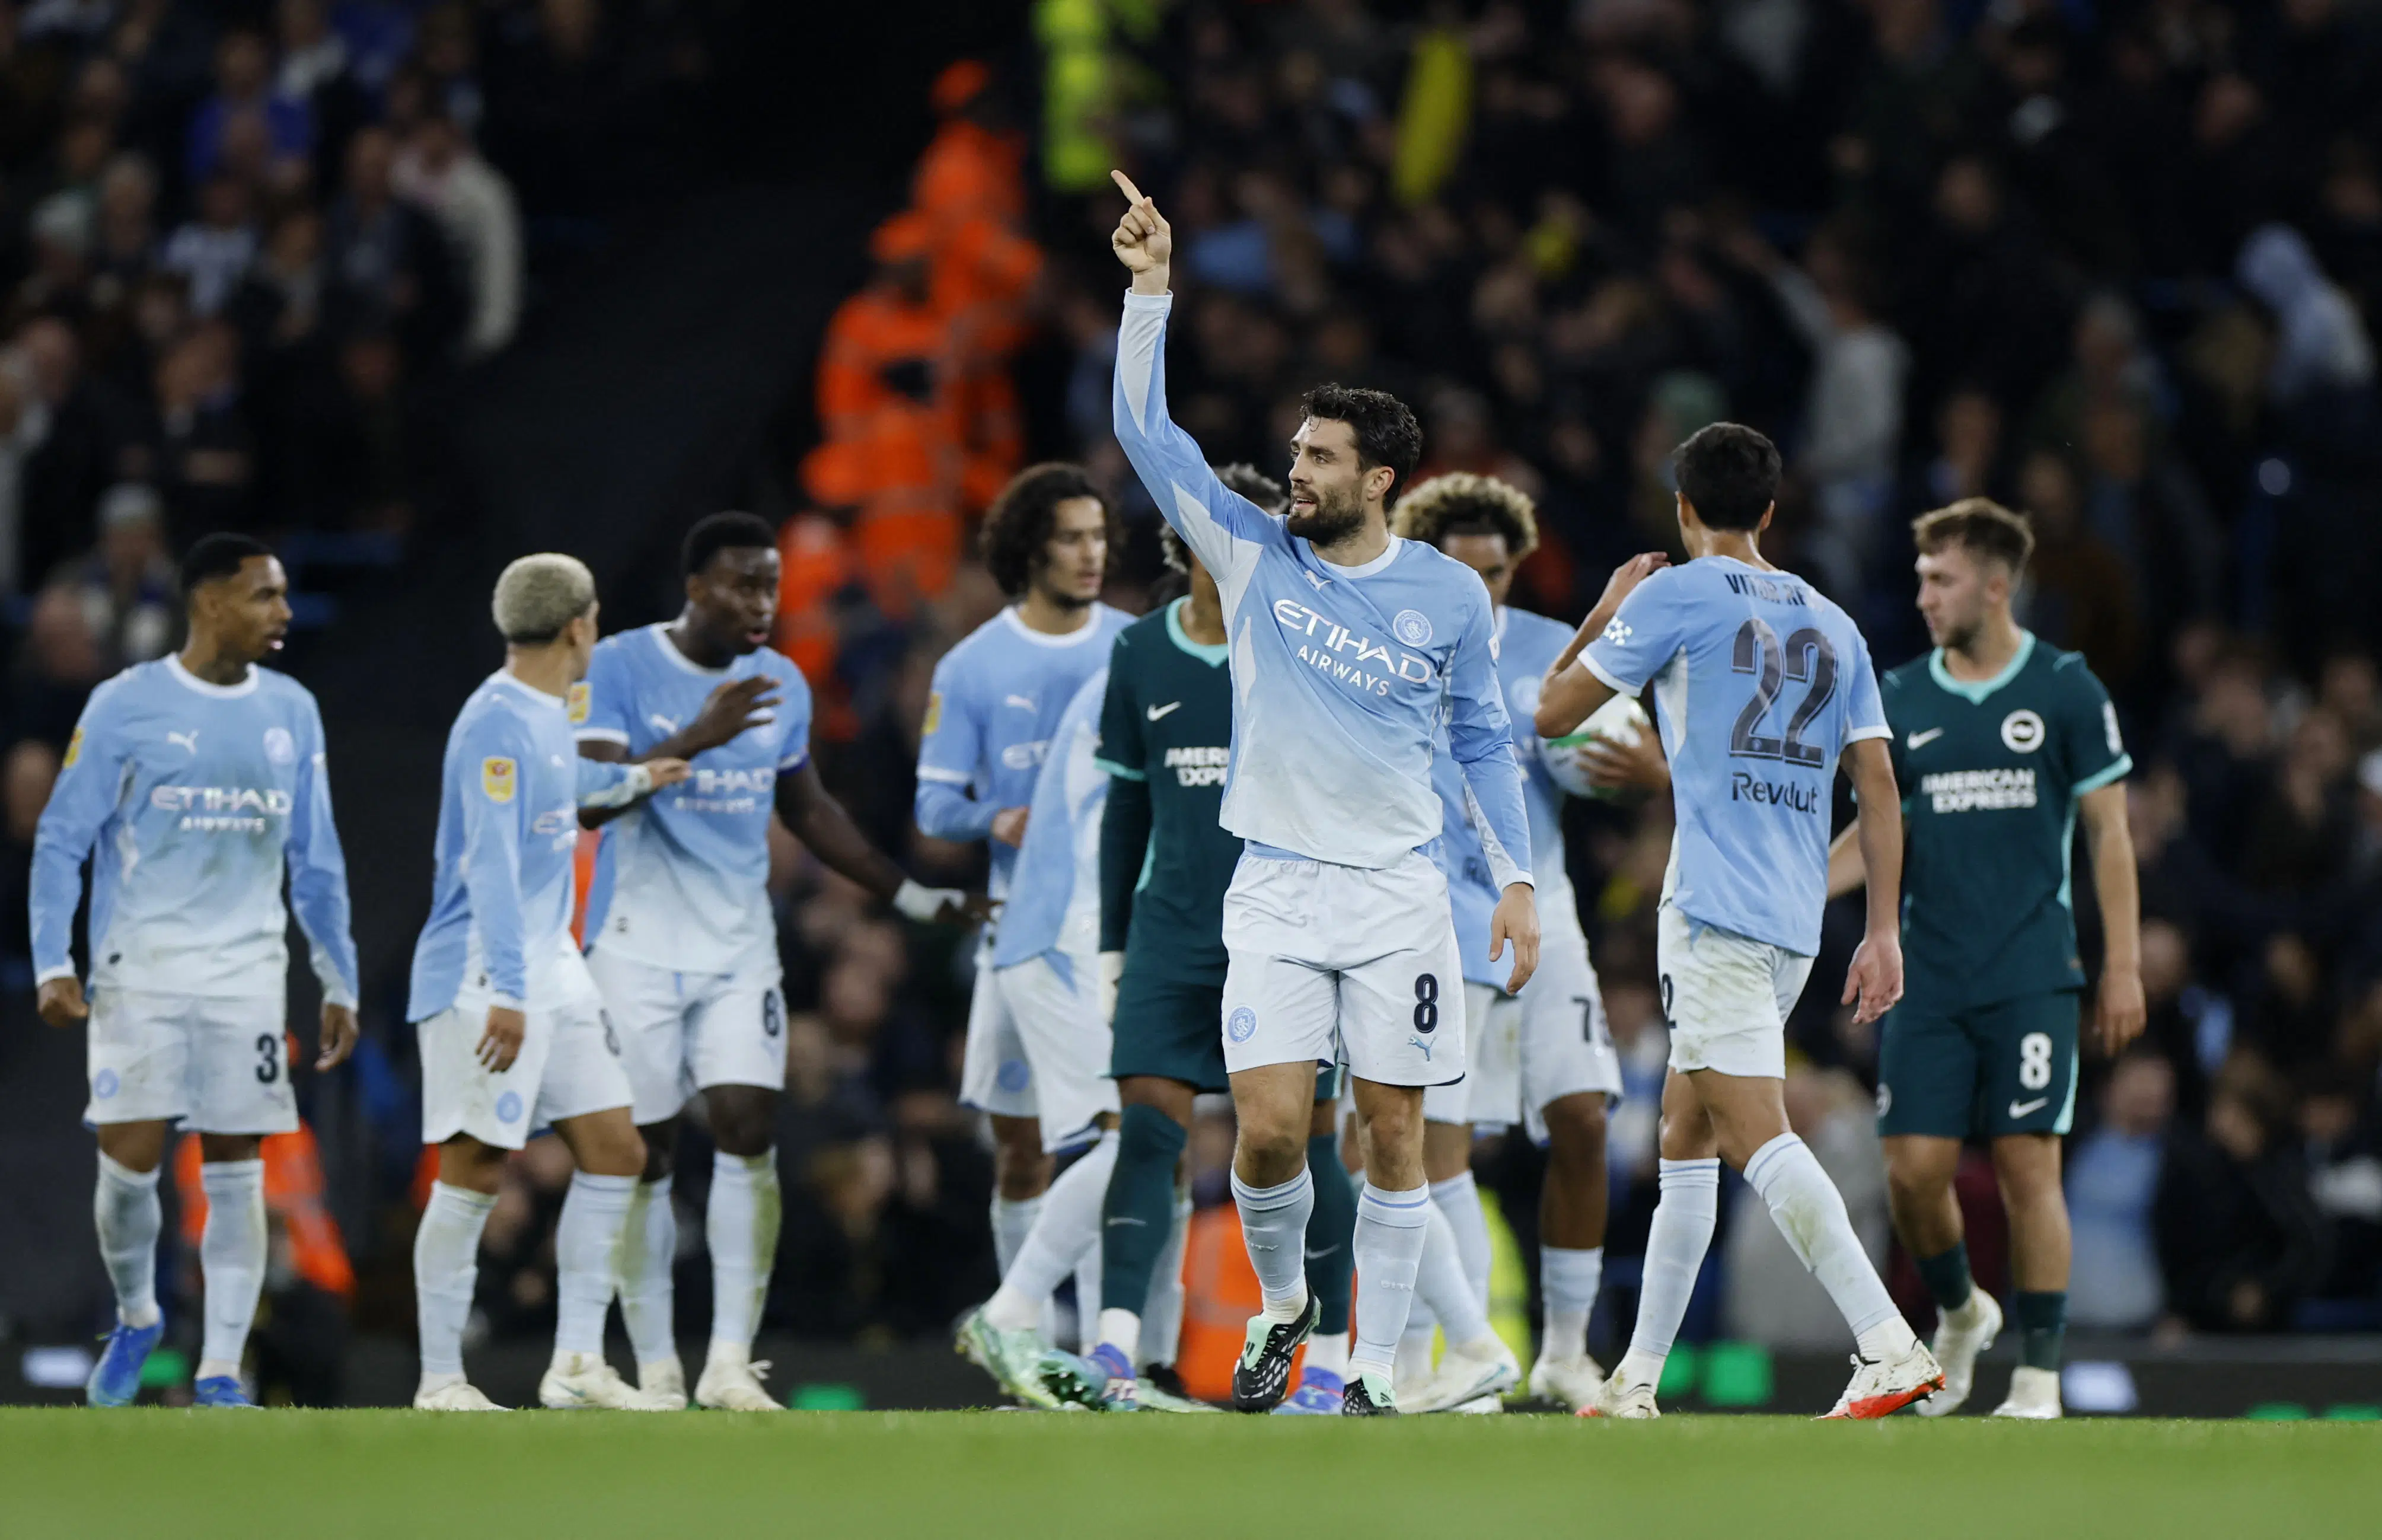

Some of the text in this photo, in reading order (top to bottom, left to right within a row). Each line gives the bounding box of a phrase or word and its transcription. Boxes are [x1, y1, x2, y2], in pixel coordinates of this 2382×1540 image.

[1274, 599, 1431, 684] ETIHAD
[1296, 644, 1390, 697] AIRWAYS
[1729, 617, 1838, 769] 22
[151, 785, 292, 816] ETIHAD
[1921, 768, 2036, 795] AMERICAN
[1932, 789, 2037, 814] EXPRESS
[1414, 973, 1439, 1034] 8
[1570, 996, 1591, 1043] 7
[256, 1034, 277, 1083] 3
[2020, 1032, 2052, 1091] 8
